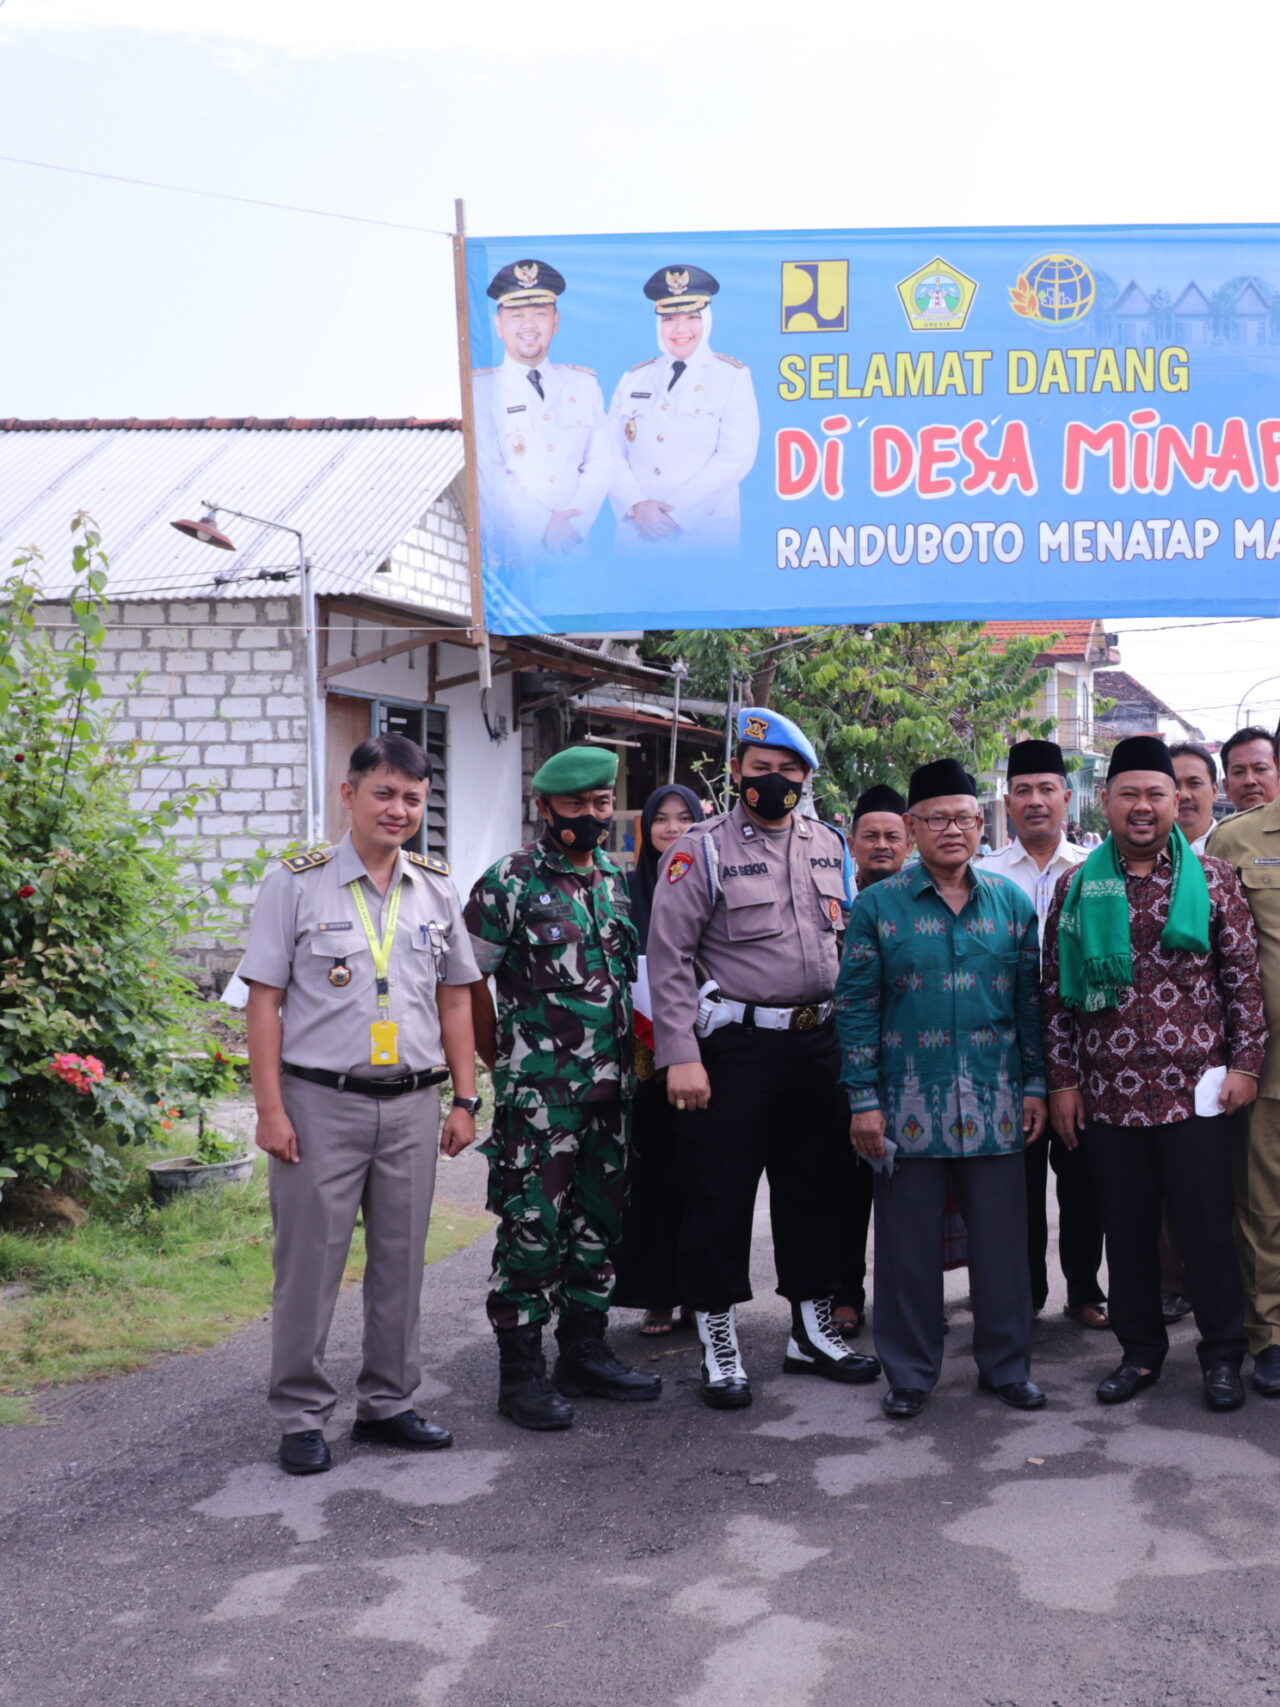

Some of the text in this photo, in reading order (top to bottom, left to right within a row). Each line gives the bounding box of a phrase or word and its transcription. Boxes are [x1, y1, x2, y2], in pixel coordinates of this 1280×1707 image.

[778, 346, 1189, 401] SELAMAT DATANG
[871, 418, 1039, 498] DESA
[776, 521, 1024, 570] RANDUBOTO
[1038, 518, 1219, 563] MENATAP
